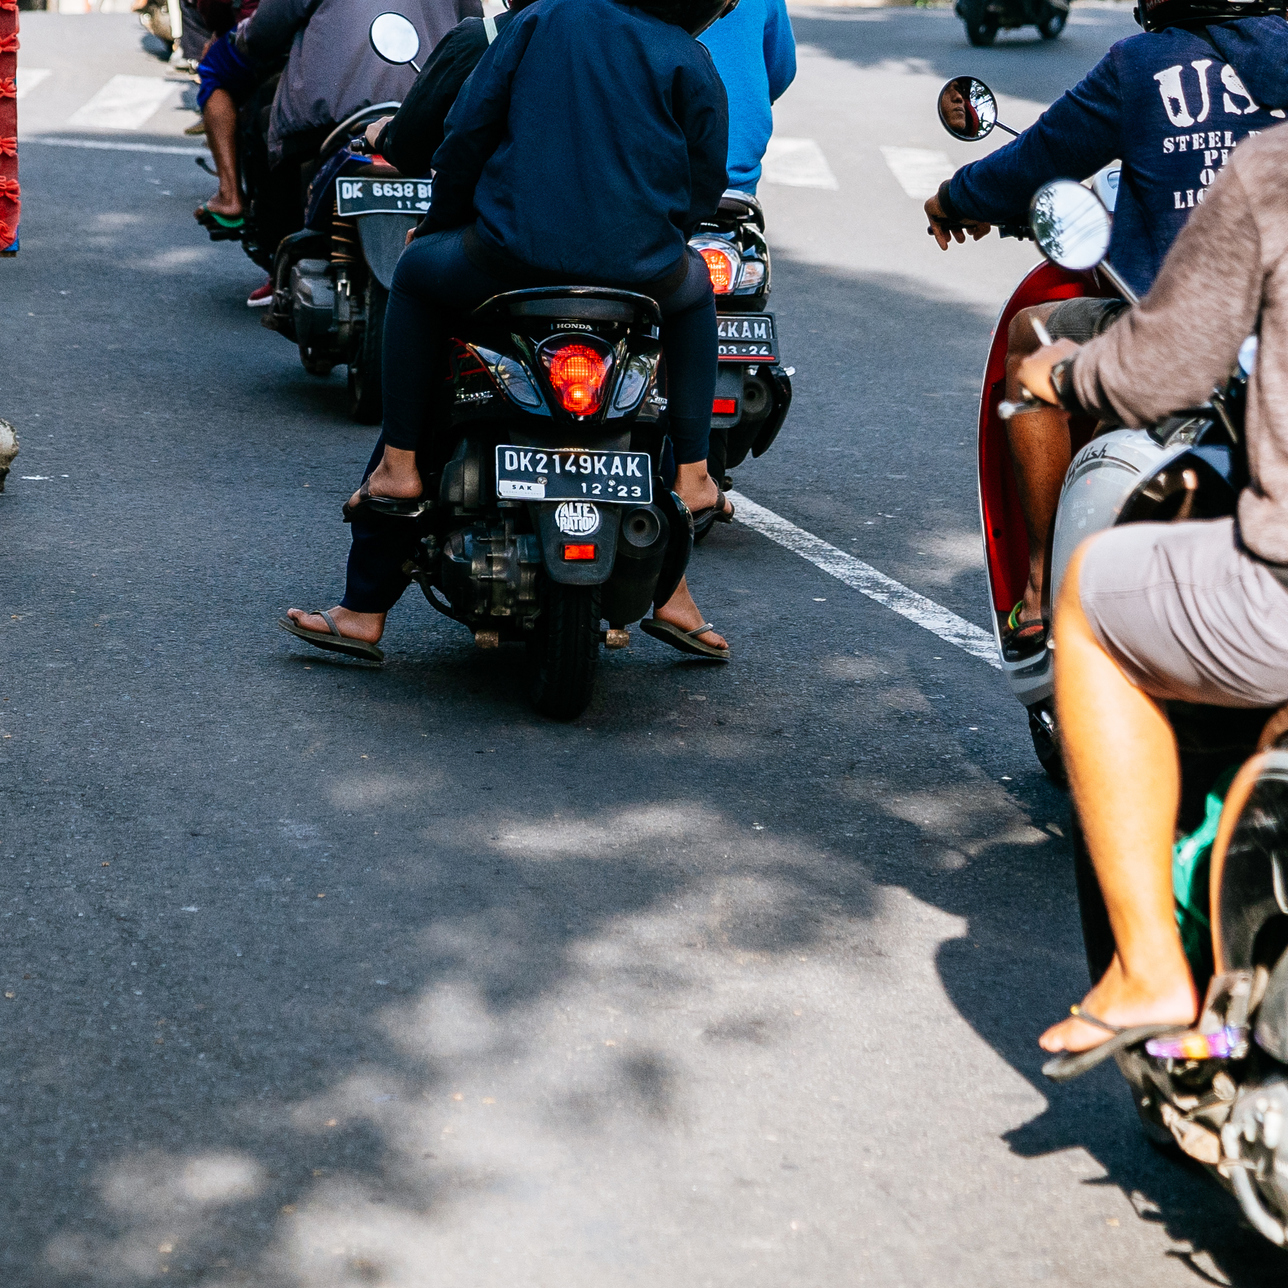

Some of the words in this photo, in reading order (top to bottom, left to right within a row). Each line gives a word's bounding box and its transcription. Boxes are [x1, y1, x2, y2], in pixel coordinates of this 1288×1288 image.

[1163, 130, 1237, 154] STEEL
[342, 182, 363, 200] DK
[372, 182, 414, 198] 6638
[556, 323, 593, 331] HONDA
